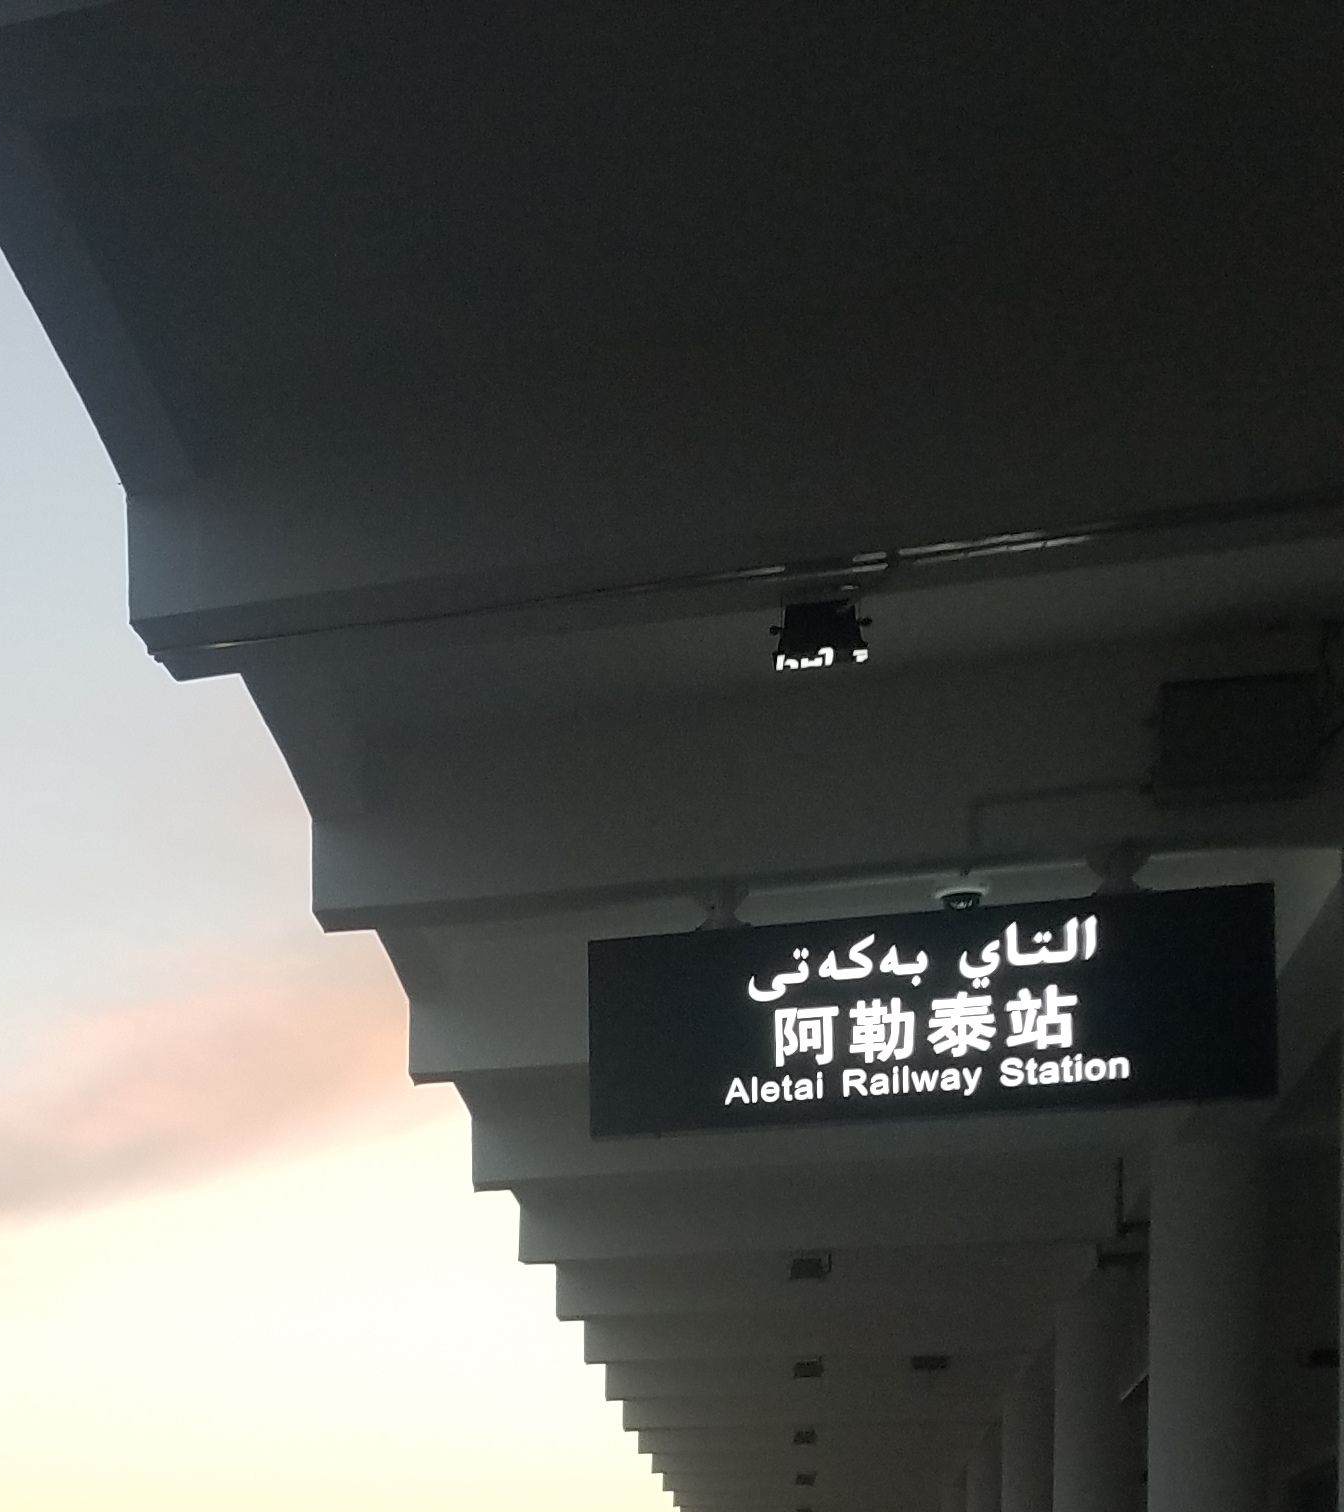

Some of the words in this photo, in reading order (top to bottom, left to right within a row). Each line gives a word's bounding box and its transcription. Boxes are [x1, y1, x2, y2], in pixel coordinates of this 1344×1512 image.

[774, 984, 1079, 1068] 阿勒泰站
[724, 1070, 824, 1105] Aletai
[842, 1064, 983, 1098] Railway
[999, 1052, 1130, 1088] Station
